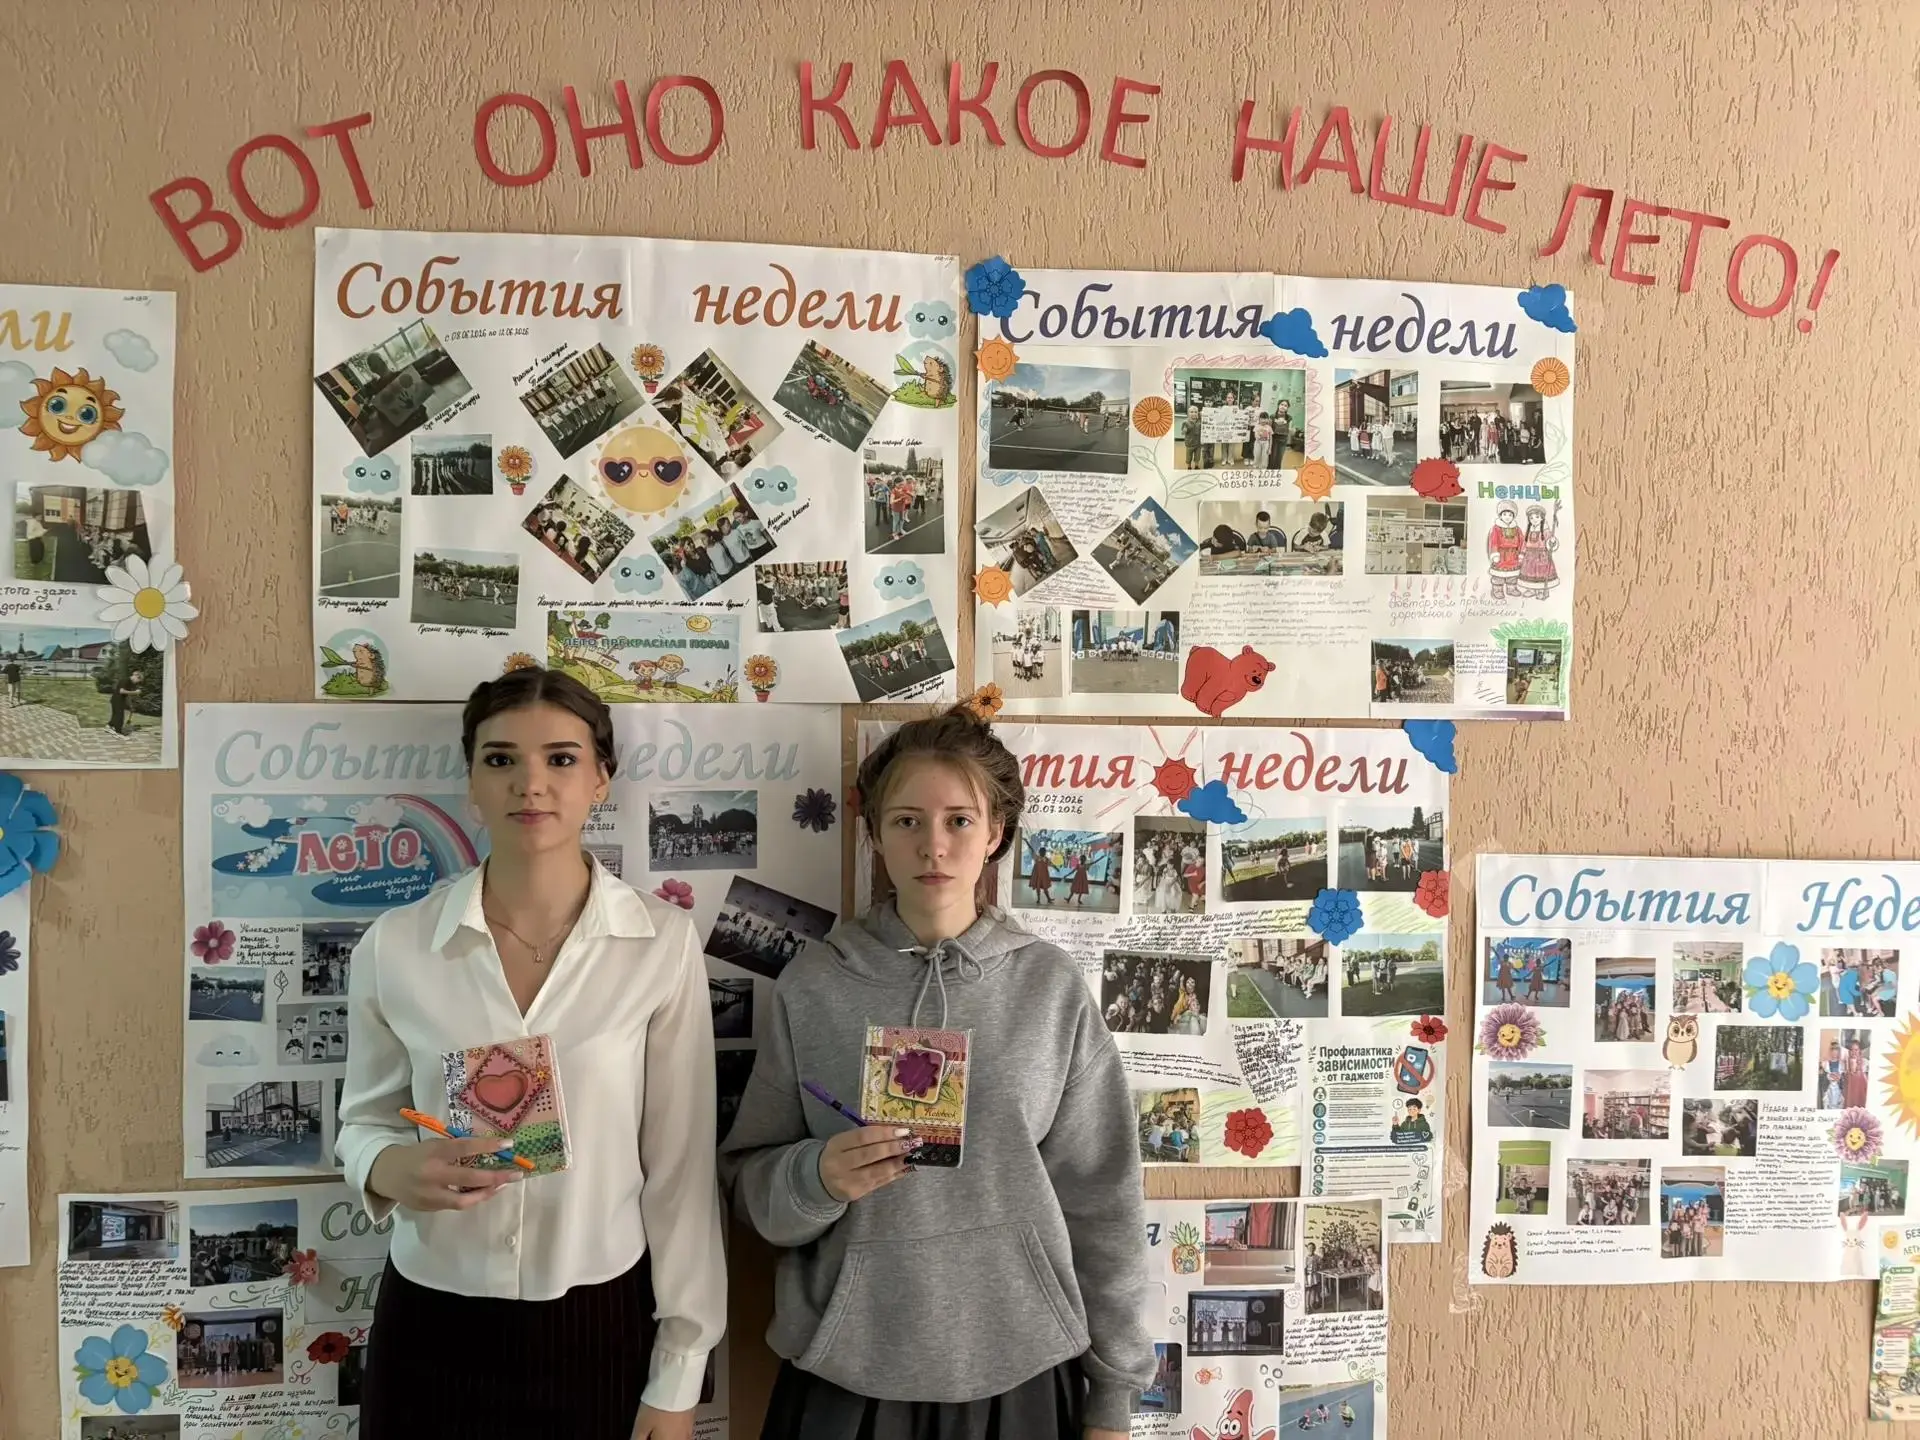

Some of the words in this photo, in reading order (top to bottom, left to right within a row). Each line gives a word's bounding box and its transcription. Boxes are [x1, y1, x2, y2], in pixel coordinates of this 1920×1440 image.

[148, 111, 376, 273] ВОТ
[473, 74, 725, 188] ОНО
[799, 59, 1161, 169] КАКОЕ
[1231, 99, 1528, 234] НАШЕ
[1539, 184, 1840, 334] ЛЕТО!
[336, 255, 623, 320] События
[694, 262, 903, 333] недели
[1000, 283, 1264, 343] События
[1331, 292, 1518, 358] недели
[1477, 481, 1560, 501] Ненцы
[0, 587, 31, 595] тота
[0, 597, 62, 616] доровья!
[601, 637, 687, 649] ПРЕКРАСНАЯ
[214, 722, 468, 788] Событи
[1218, 731, 1409, 794] недели
[332, 874, 362, 884] это
[341, 874, 421, 893] маленькая
[1499, 868, 1750, 926] События
[1319, 1045, 1393, 1058] Профилактика
[1327, 1073, 1337, 1082] от
[1340, 1072, 1384, 1083] гаджетов
